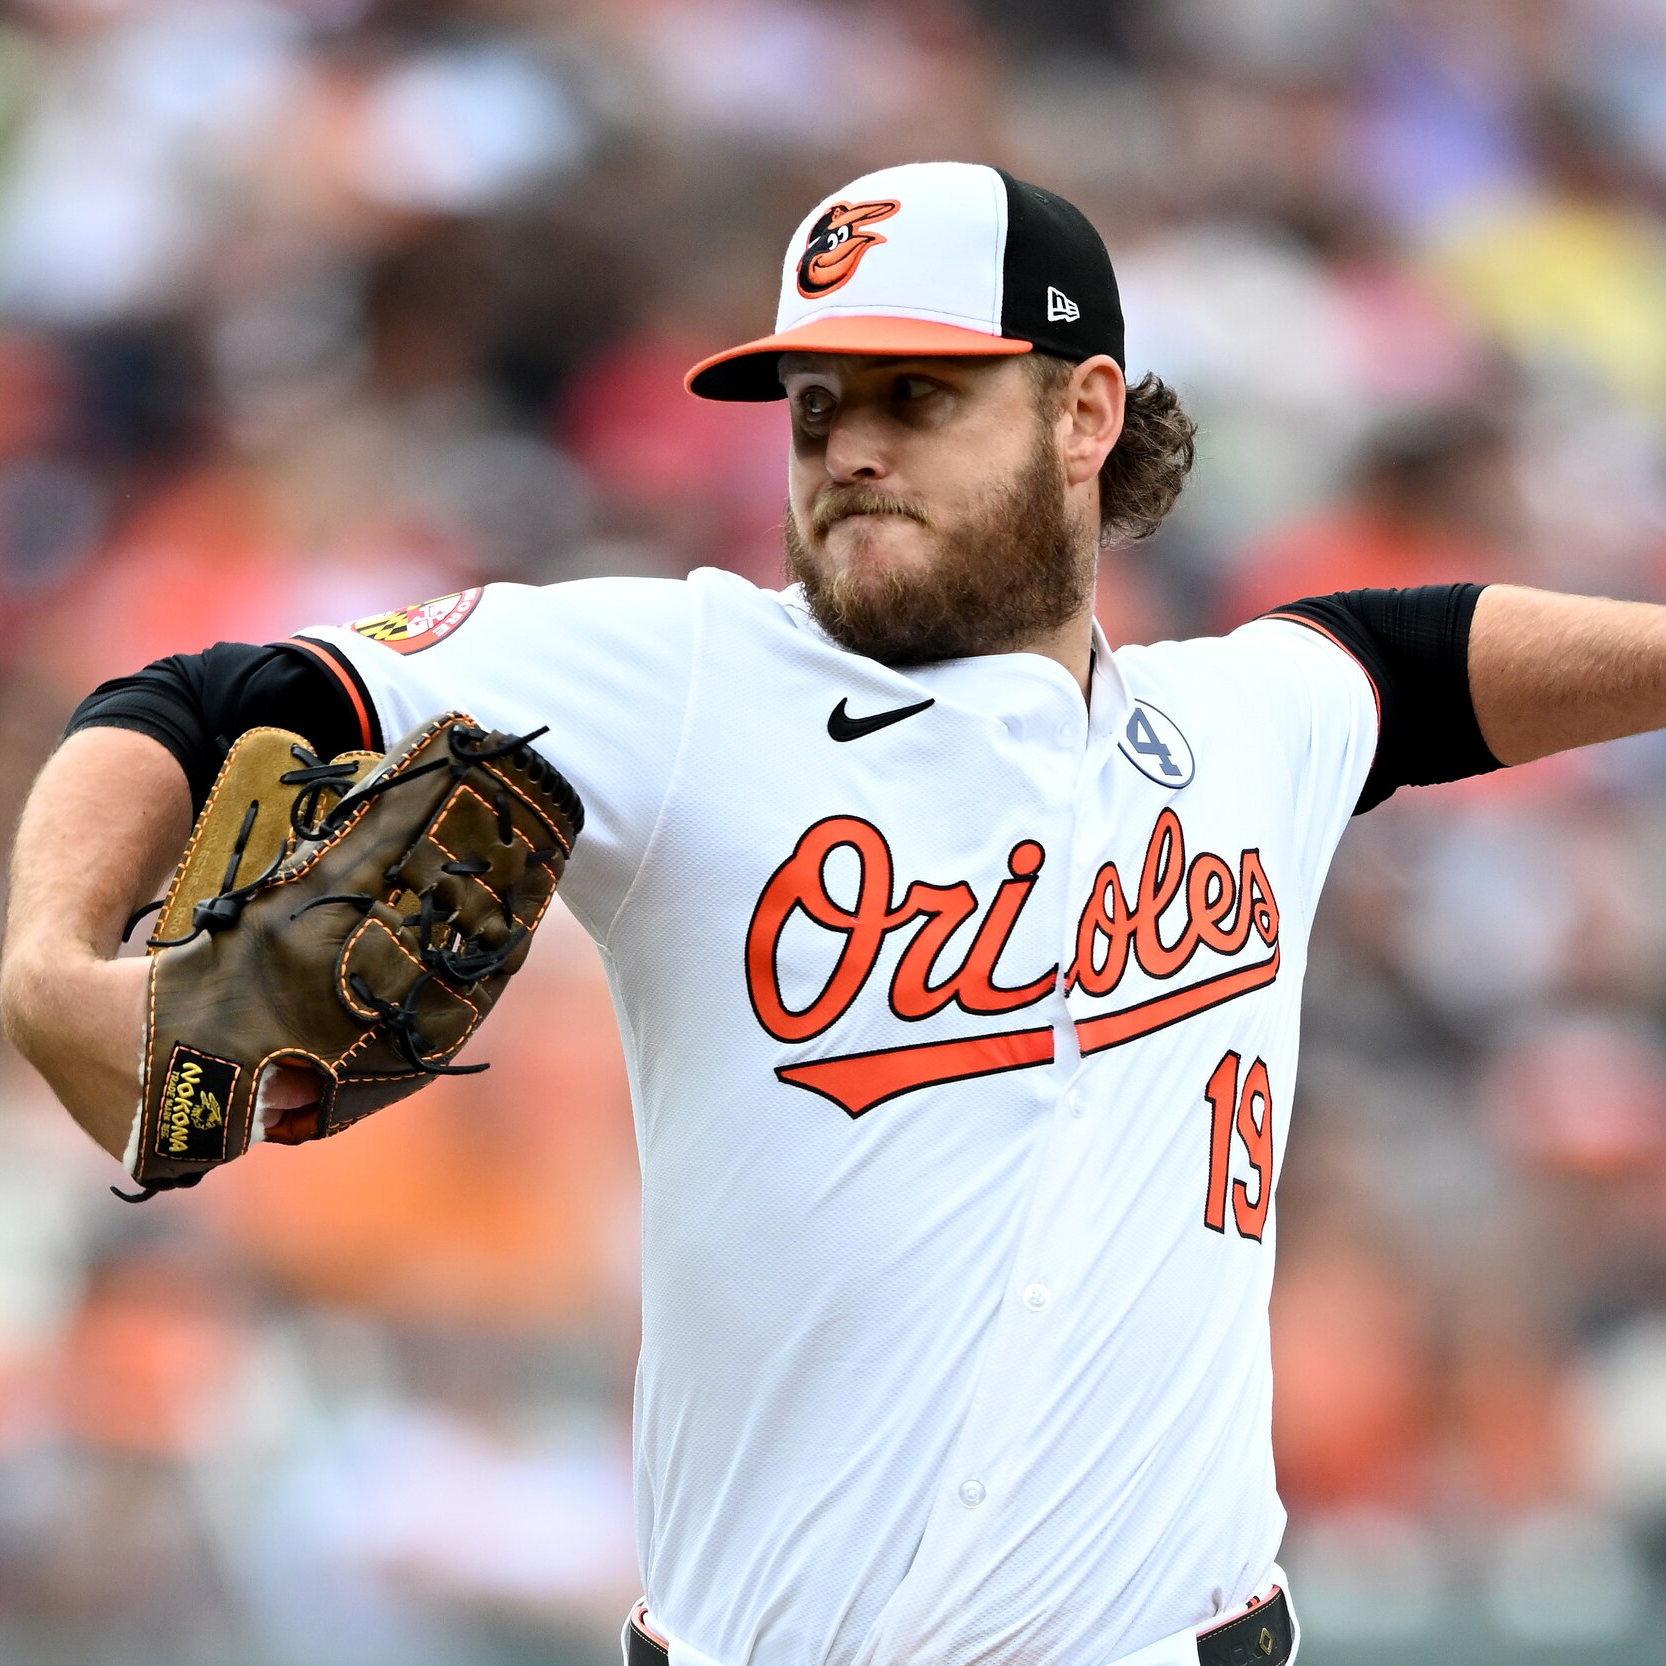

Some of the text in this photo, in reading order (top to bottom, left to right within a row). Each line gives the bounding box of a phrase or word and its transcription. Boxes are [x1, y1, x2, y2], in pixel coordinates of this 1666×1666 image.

[1126, 707, 1183, 777] 4
[744, 806, 1280, 1044] Orioles
[167, 1070, 180, 1098] TRADE
[169, 1062, 203, 1152] NOKONA
[1204, 1048, 1273, 1245] 19
